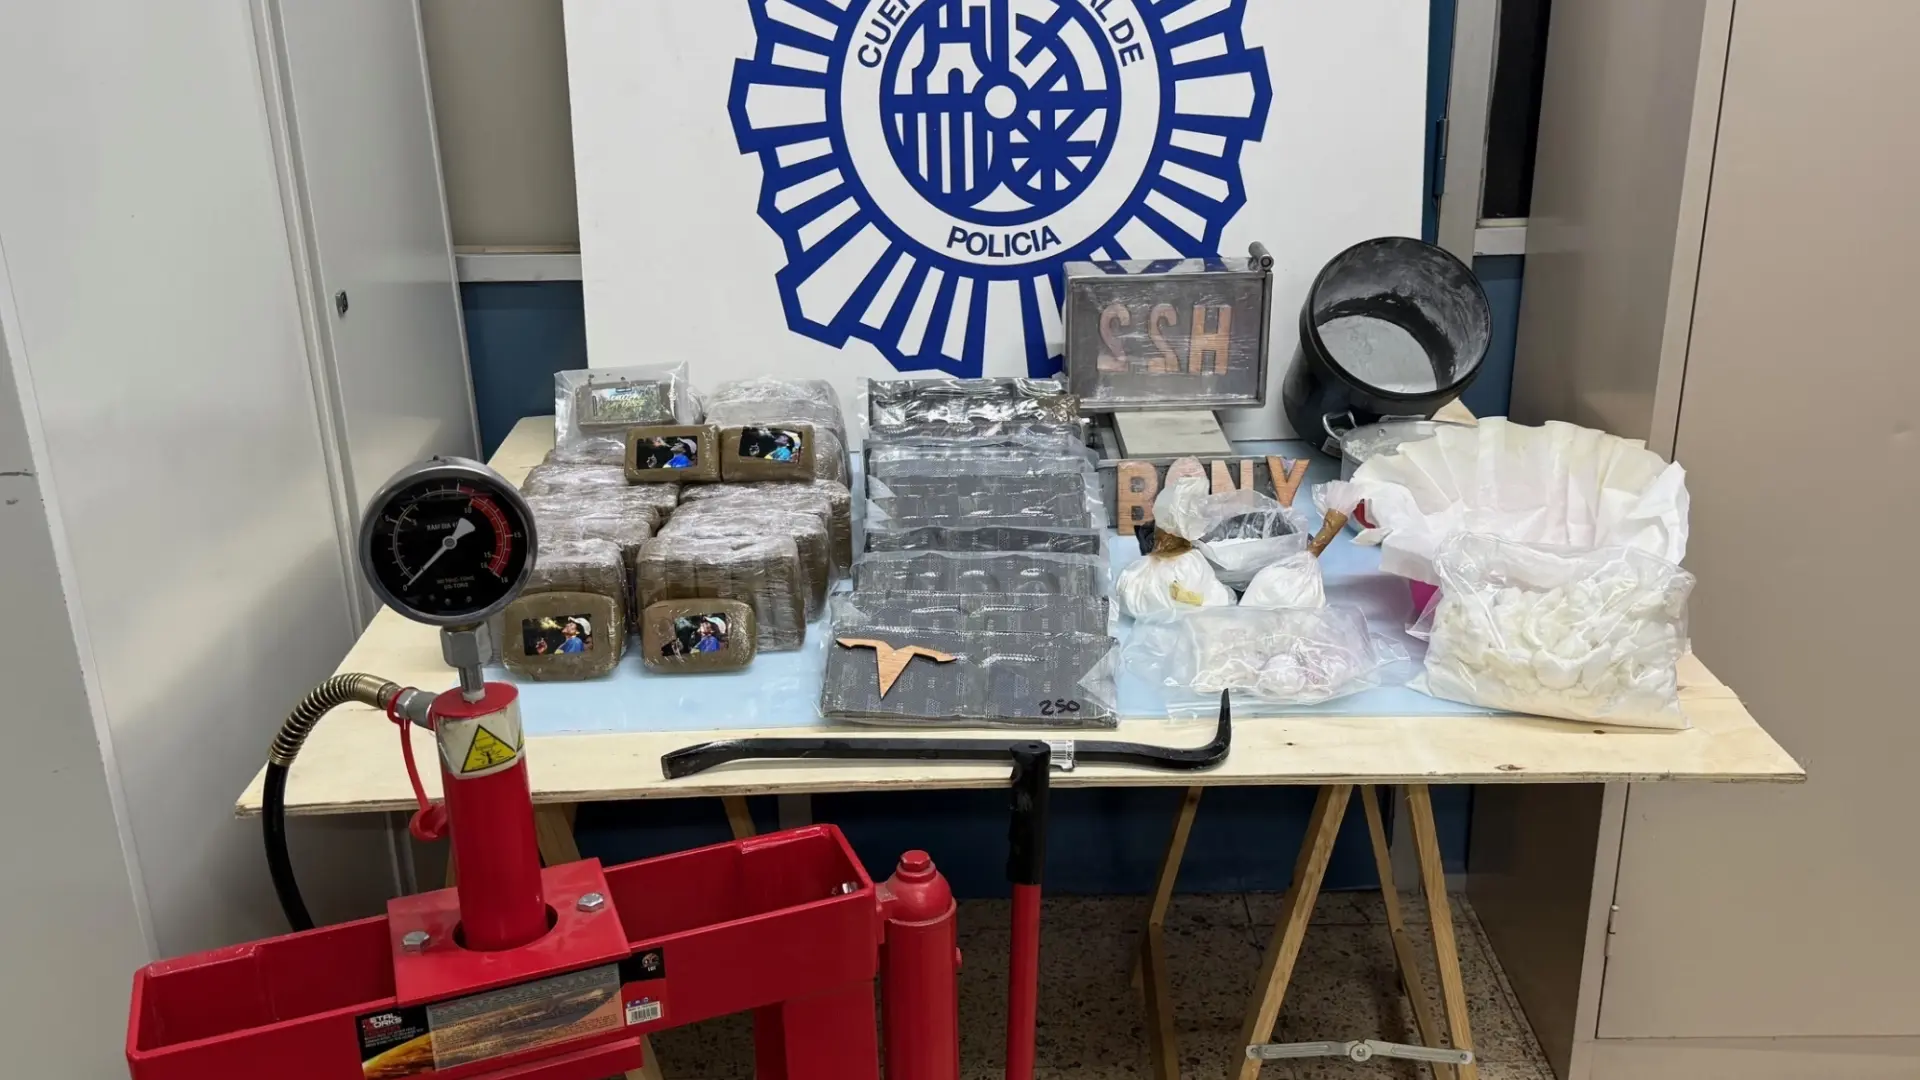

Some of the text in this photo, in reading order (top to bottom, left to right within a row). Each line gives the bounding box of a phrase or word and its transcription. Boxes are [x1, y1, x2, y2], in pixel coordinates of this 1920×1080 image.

[1109, 18, 1144, 67] DE
[947, 225, 1061, 258] POLICIA
[1039, 698, 1080, 715] 250
